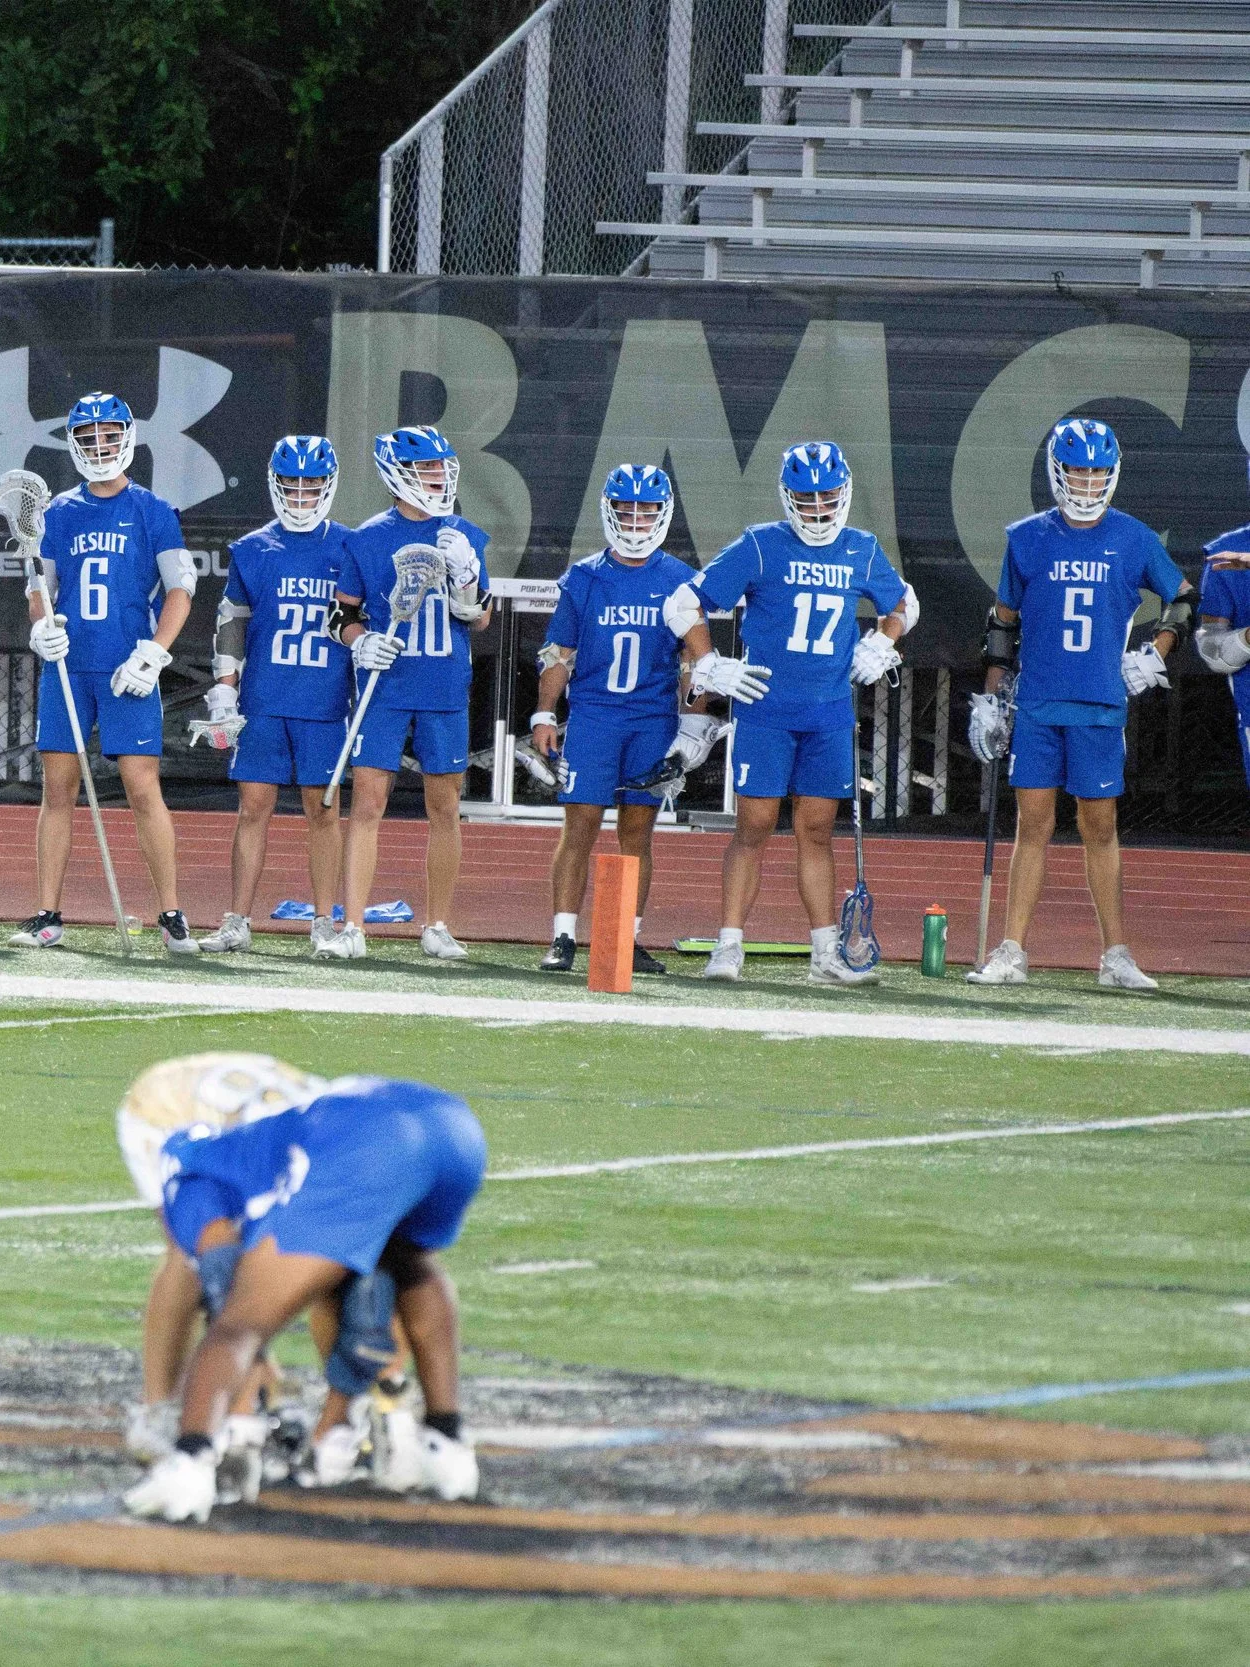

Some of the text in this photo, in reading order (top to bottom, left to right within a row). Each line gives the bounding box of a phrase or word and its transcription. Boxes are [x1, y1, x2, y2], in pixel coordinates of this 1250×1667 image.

[322, 311, 1191, 632] BMC
[70, 532, 128, 556] JESUIT
[80, 557, 108, 620] 6
[277, 577, 338, 600] JESUIT
[784, 561, 854, 590] JESUIT
[1049, 561, 1111, 583] JESUIT
[271, 603, 329, 668] 22
[599, 605, 660, 627] JESUIT
[786, 592, 845, 656] 17
[1063, 587, 1094, 652] 5
[607, 632, 641, 693] 0
[737, 763, 750, 787] J
